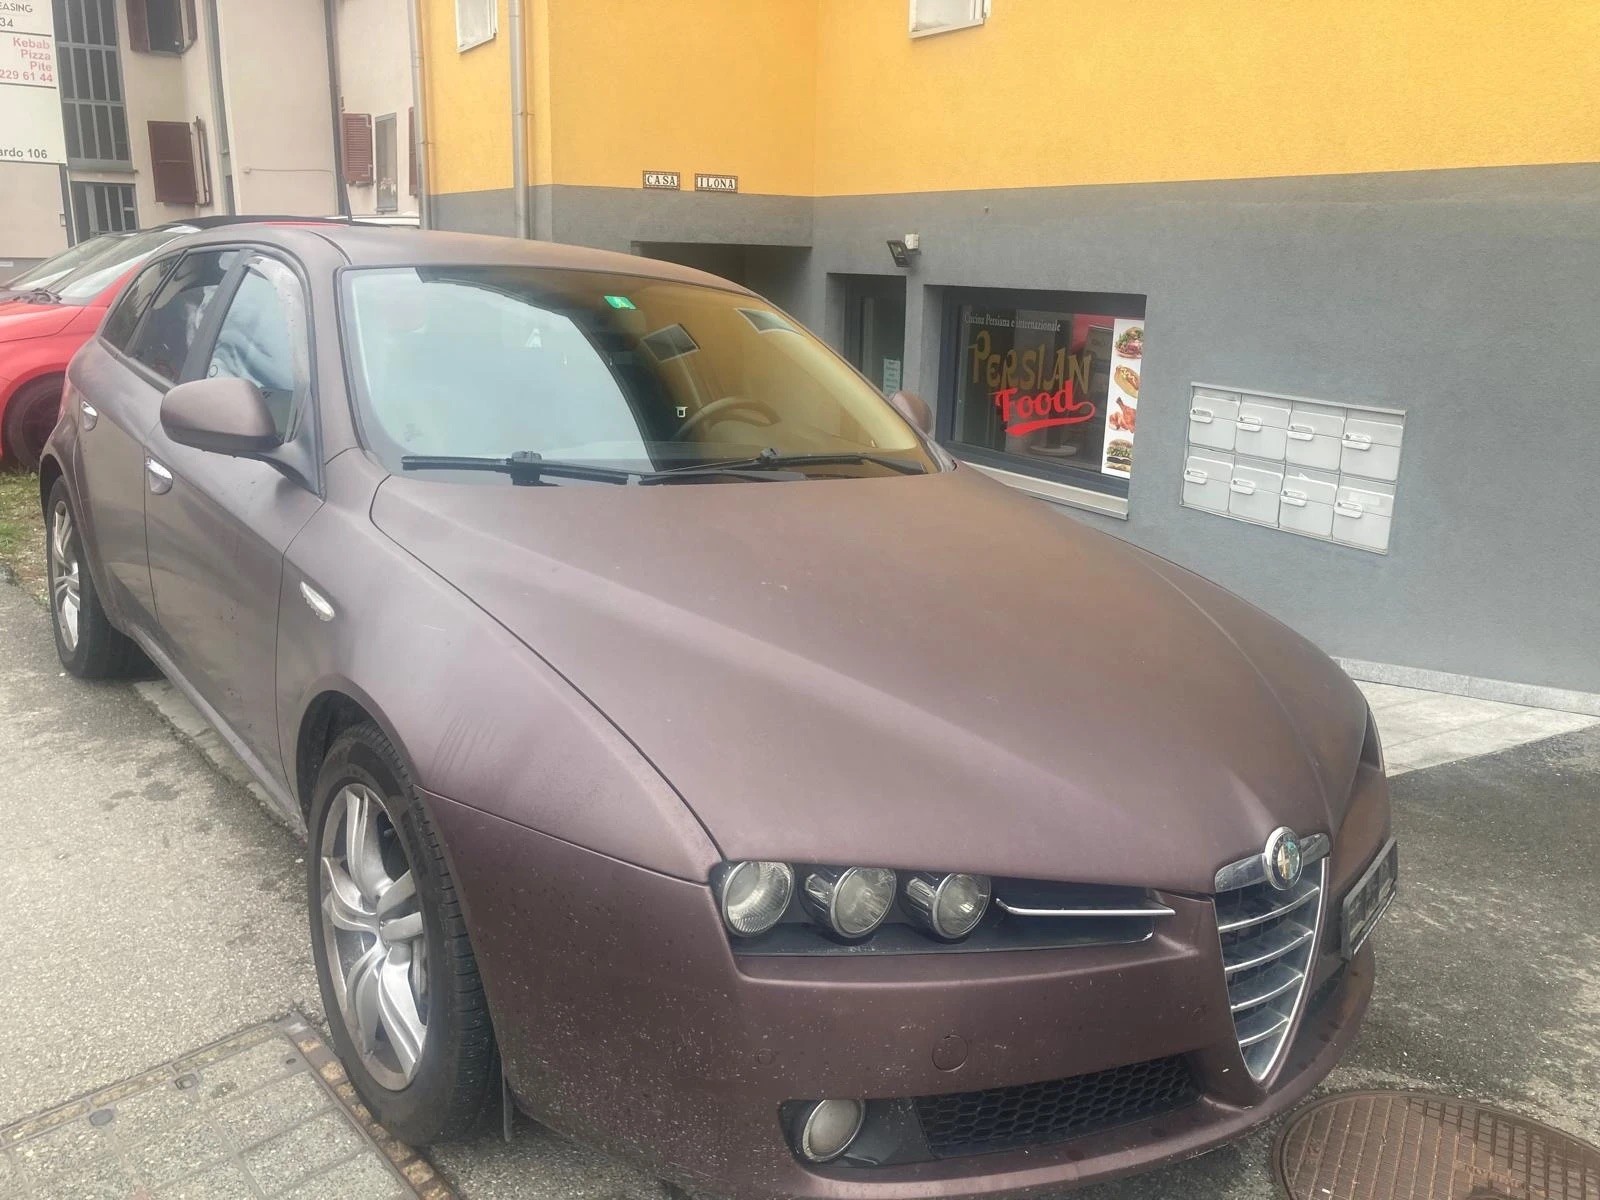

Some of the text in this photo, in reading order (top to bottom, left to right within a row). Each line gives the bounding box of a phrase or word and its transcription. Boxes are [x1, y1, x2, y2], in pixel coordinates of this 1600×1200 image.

[0, 17, 14, 27] 34
[13, 37, 50, 49] Kebab
[21, 49, 51, 60] Pizza
[30, 61, 52, 71] Pite
[23, 71, 35, 81] 61
[40, 73, 53, 82] 44
[28, 148, 48, 159] 106
[647, 174, 734, 189] CASA ILONA
[963, 313, 985, 326] Cucina
[986, 313, 1010, 328] Persiana
[995, 379, 1096, 436] Food
